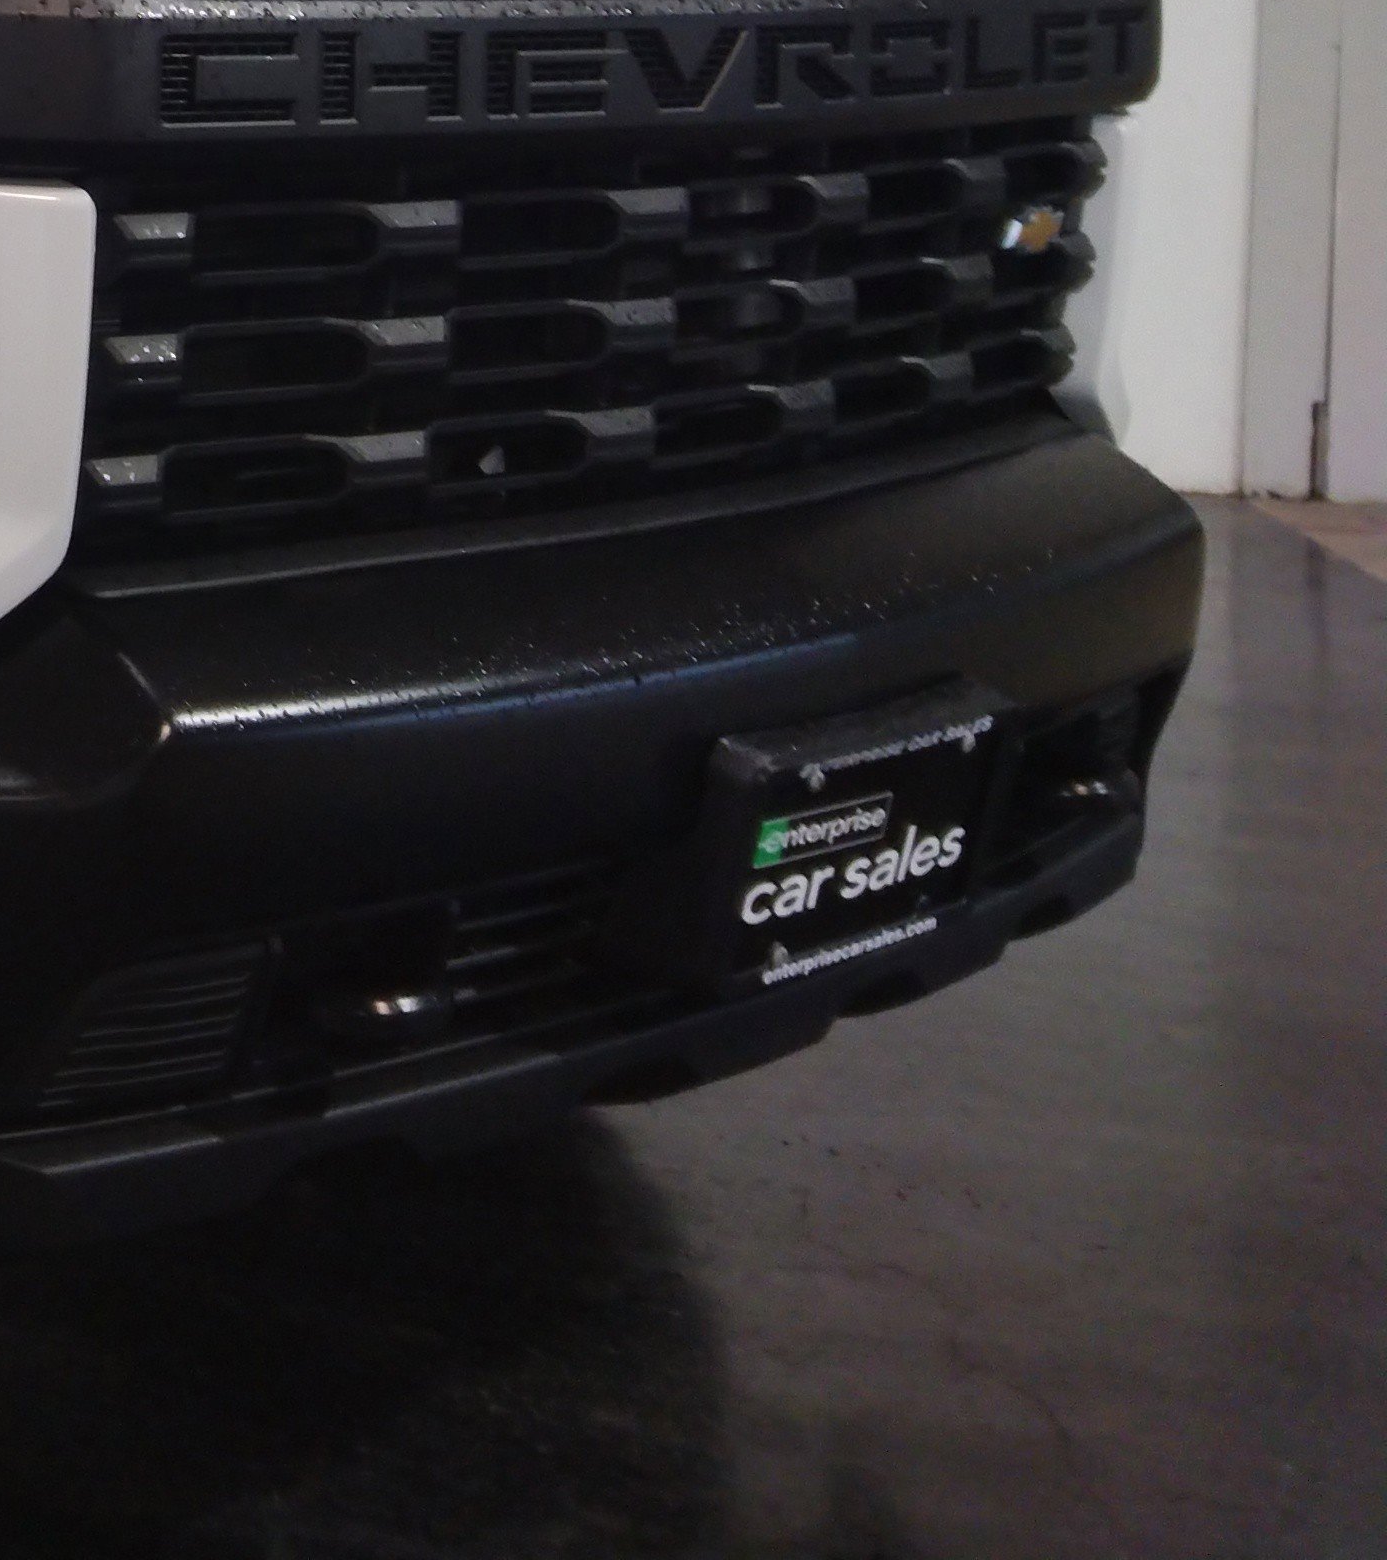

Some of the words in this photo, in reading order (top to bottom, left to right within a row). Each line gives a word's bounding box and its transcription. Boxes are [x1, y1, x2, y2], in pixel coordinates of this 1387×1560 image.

[161, 9, 1145, 127] CHEVROLET
[741, 865, 835, 925] car
[840, 824, 966, 898] sales
[759, 807, 886, 854] enterprise
